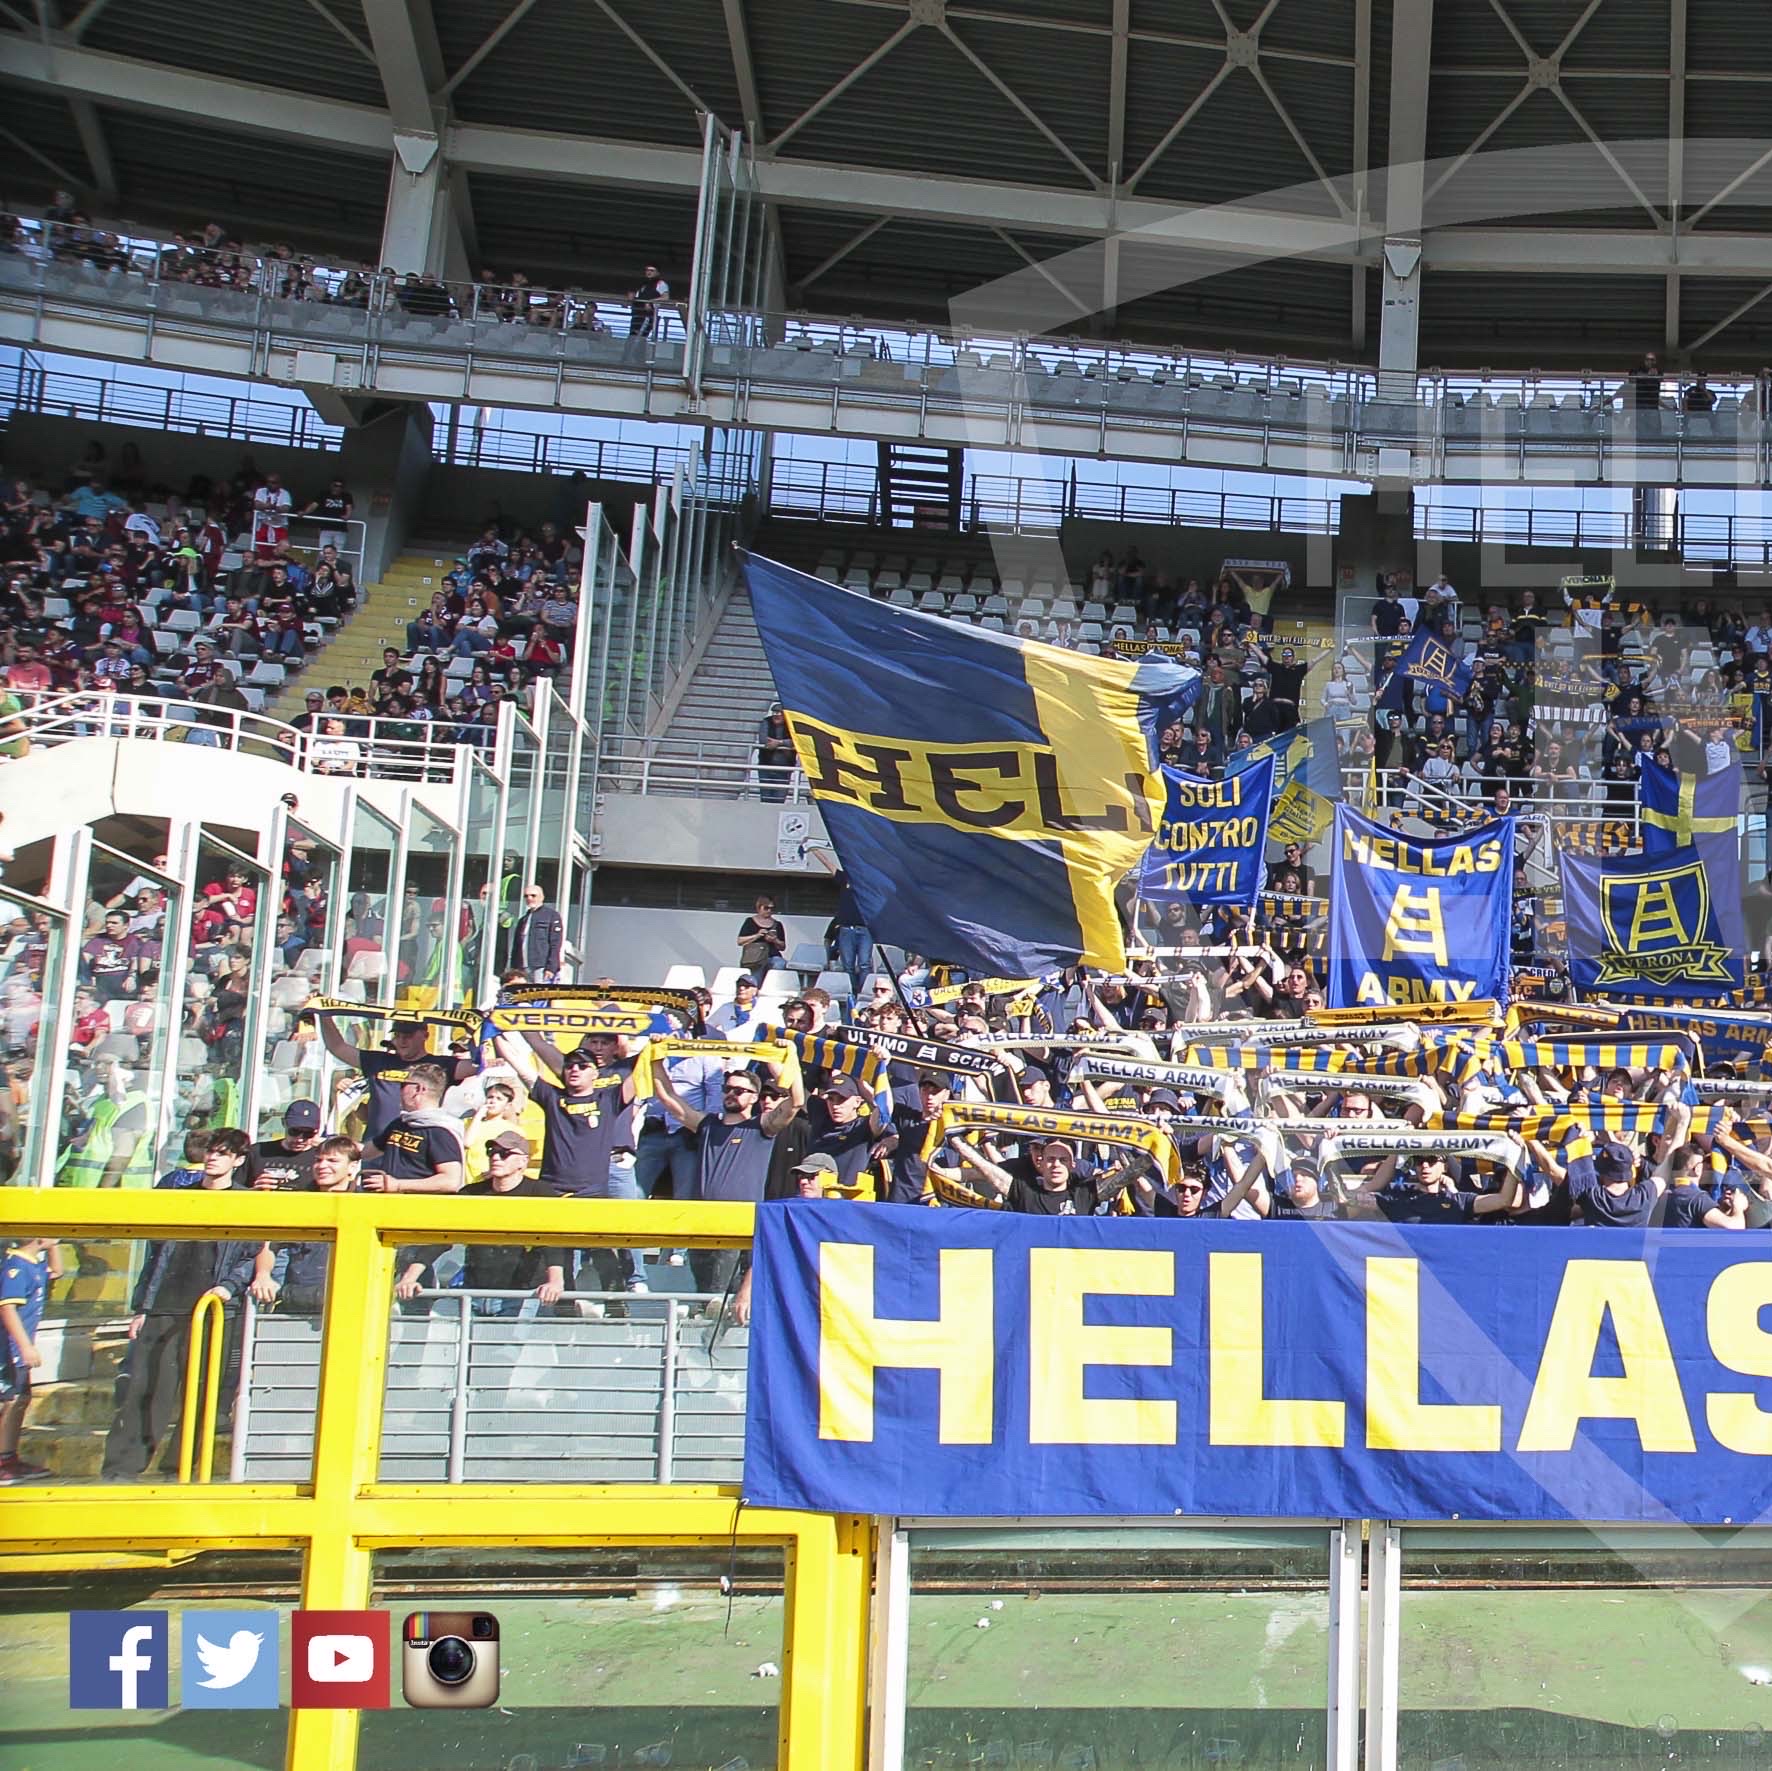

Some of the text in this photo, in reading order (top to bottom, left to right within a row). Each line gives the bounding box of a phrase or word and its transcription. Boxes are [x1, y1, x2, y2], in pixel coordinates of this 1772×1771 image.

[1179, 775, 1240, 808] SOLI
[1154, 816, 1258, 851] CONTRO
[1343, 828, 1502, 877] HELLAS
[1163, 860, 1239, 892] TUTTI
[1623, 951, 1694, 969] VERONA
[1356, 972, 1478, 1004] ARMY
[501, 1012, 638, 1029] VERONA
[1628, 1013, 1718, 1037] HELLAS
[847, 1029, 909, 1053] ULTIMO
[1260, 1029, 1391, 1044] HELLAS ARMY
[948, 1052, 1007, 1077] SCALIN
[1087, 1060, 1220, 1089] HELLAS ARMY
[1269, 1075, 1343, 1088] HELLAS
[951, 1106, 1152, 1139] HELLAS ARMY
[1341, 1137, 1496, 1150] HELLAS ARMY
